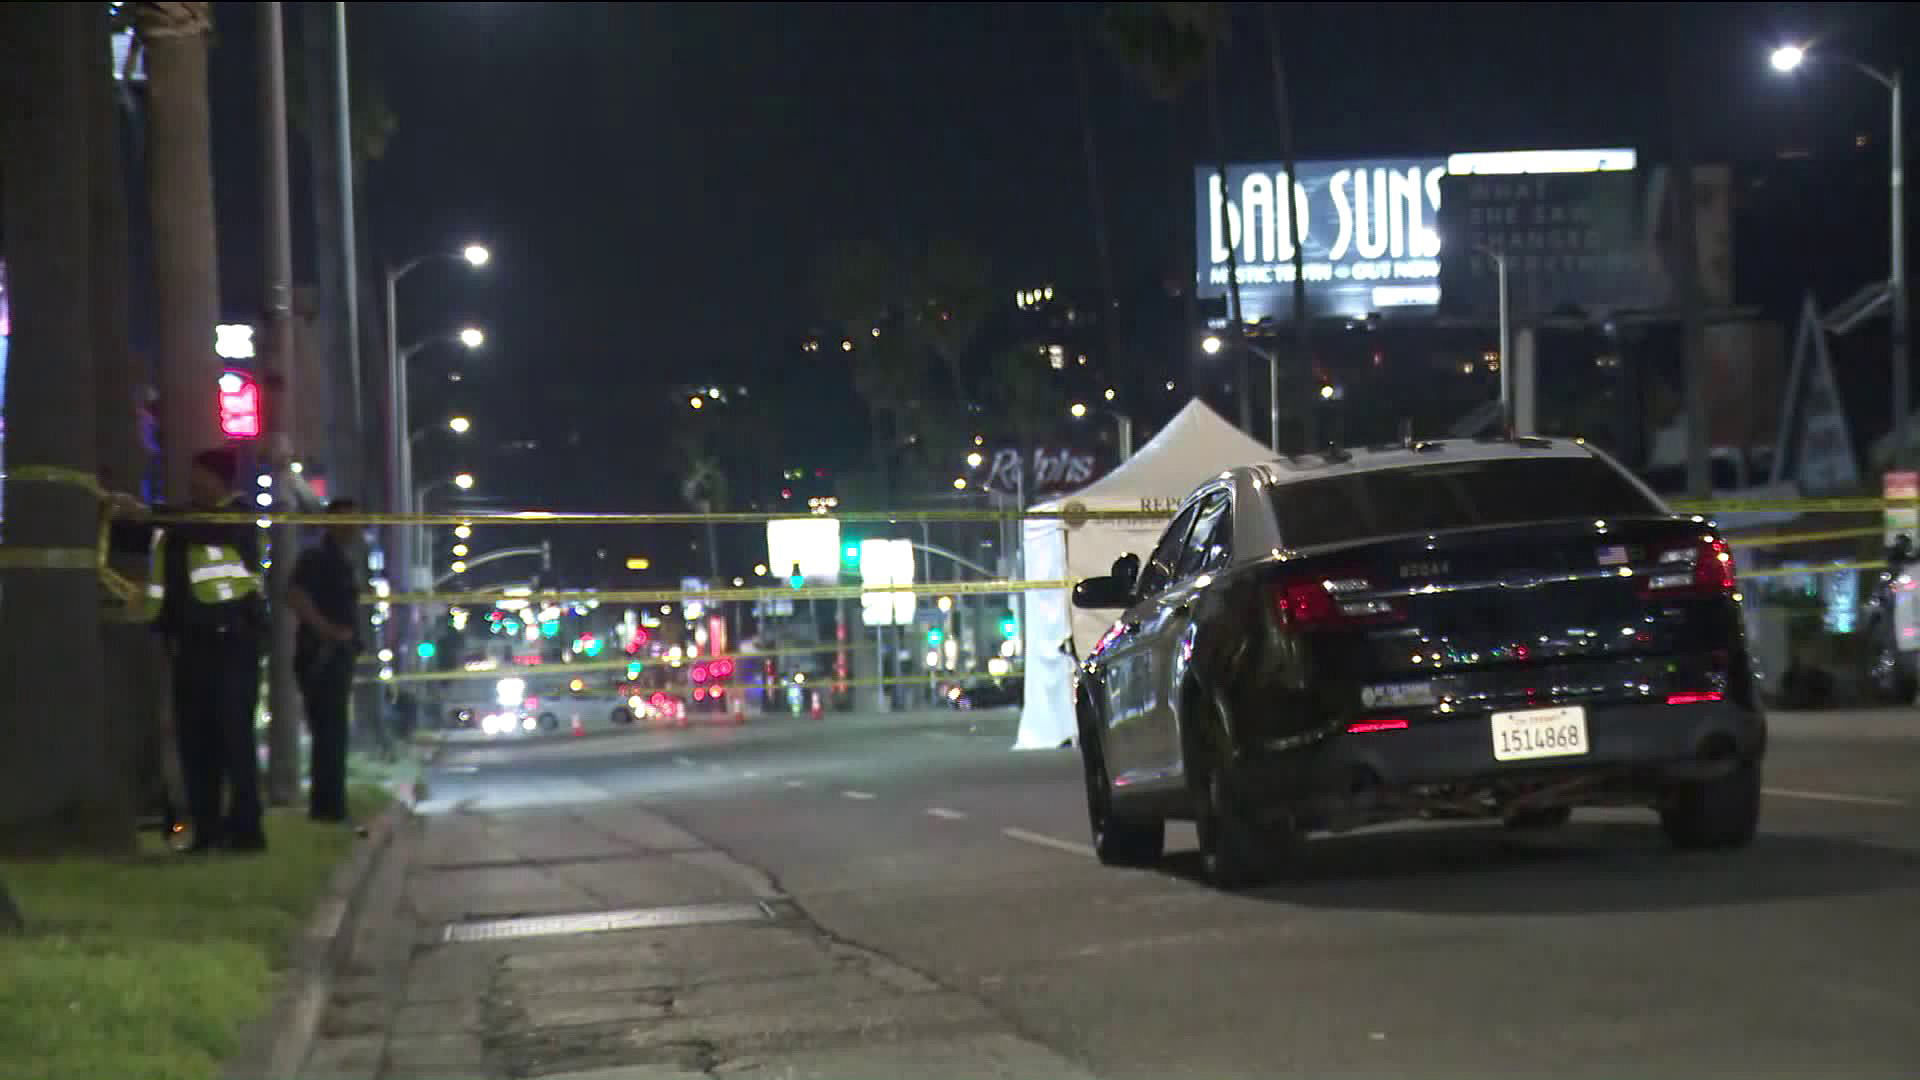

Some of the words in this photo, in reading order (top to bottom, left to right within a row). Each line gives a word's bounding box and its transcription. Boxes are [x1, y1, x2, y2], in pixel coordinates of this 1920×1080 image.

[1209, 171, 1310, 263] BAD
[1328, 166, 1446, 261] SUNS
[1210, 264, 1273, 285] MSTIC
[1501, 725, 1579, 752] 1514868
